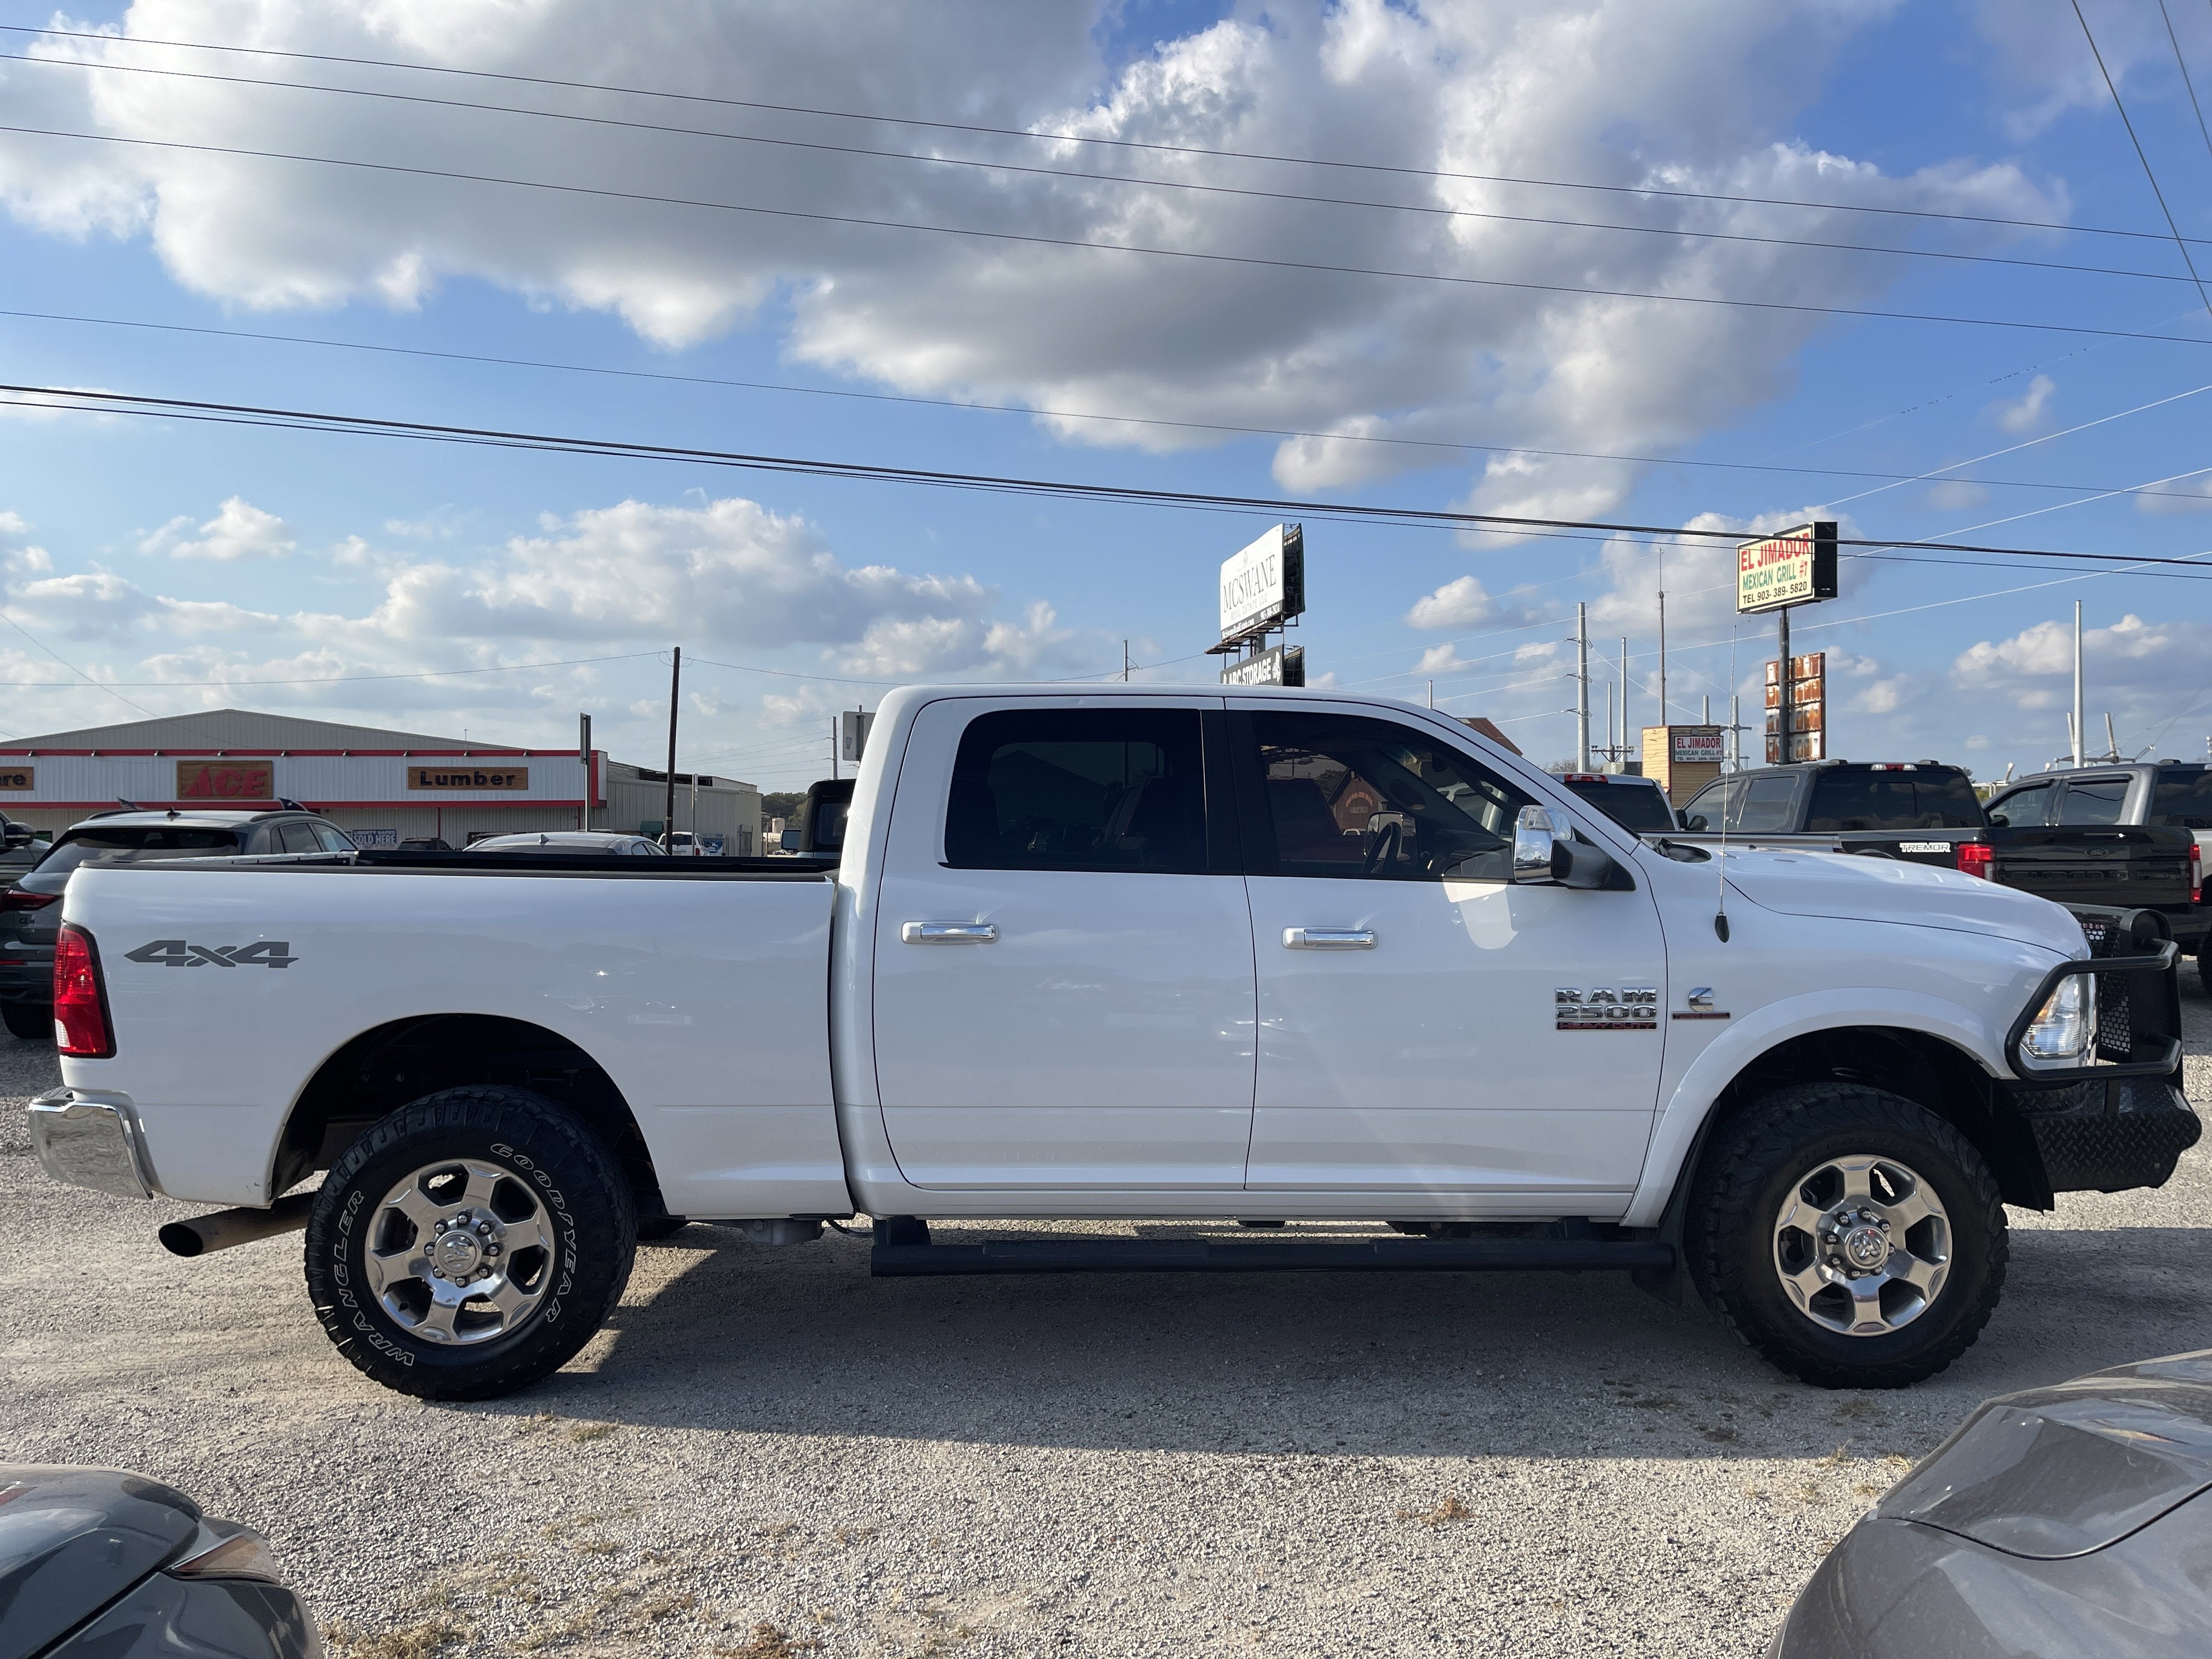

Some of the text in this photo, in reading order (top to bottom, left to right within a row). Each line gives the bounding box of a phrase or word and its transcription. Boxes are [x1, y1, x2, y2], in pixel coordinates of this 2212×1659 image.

[1741, 533, 1809, 571] EL JIMADOR
[1223, 554, 1277, 613] MCSWANE
[1743, 560, 1808, 591] MEXICAN GRILL #7
[1743, 595, 1755, 604] TEL
[1790, 582, 1807, 594] 5820
[1242, 657, 1271, 685] STORAGE
[1677, 737, 1721, 748] EL JIMADOR
[0, 774, 26, 786] re
[184, 766, 268, 796] ACE
[420, 771, 516, 786] Lumber
[353, 834, 396, 844] SOLD HERE
[1900, 843, 1951, 852] TREMOR
[1555, 988, 1657, 1003] RAM
[1555, 1004, 1657, 1020] 2500
[490, 1144, 577, 1322] GOODYEAR
[334, 1190, 415, 1366] WRANGLER
